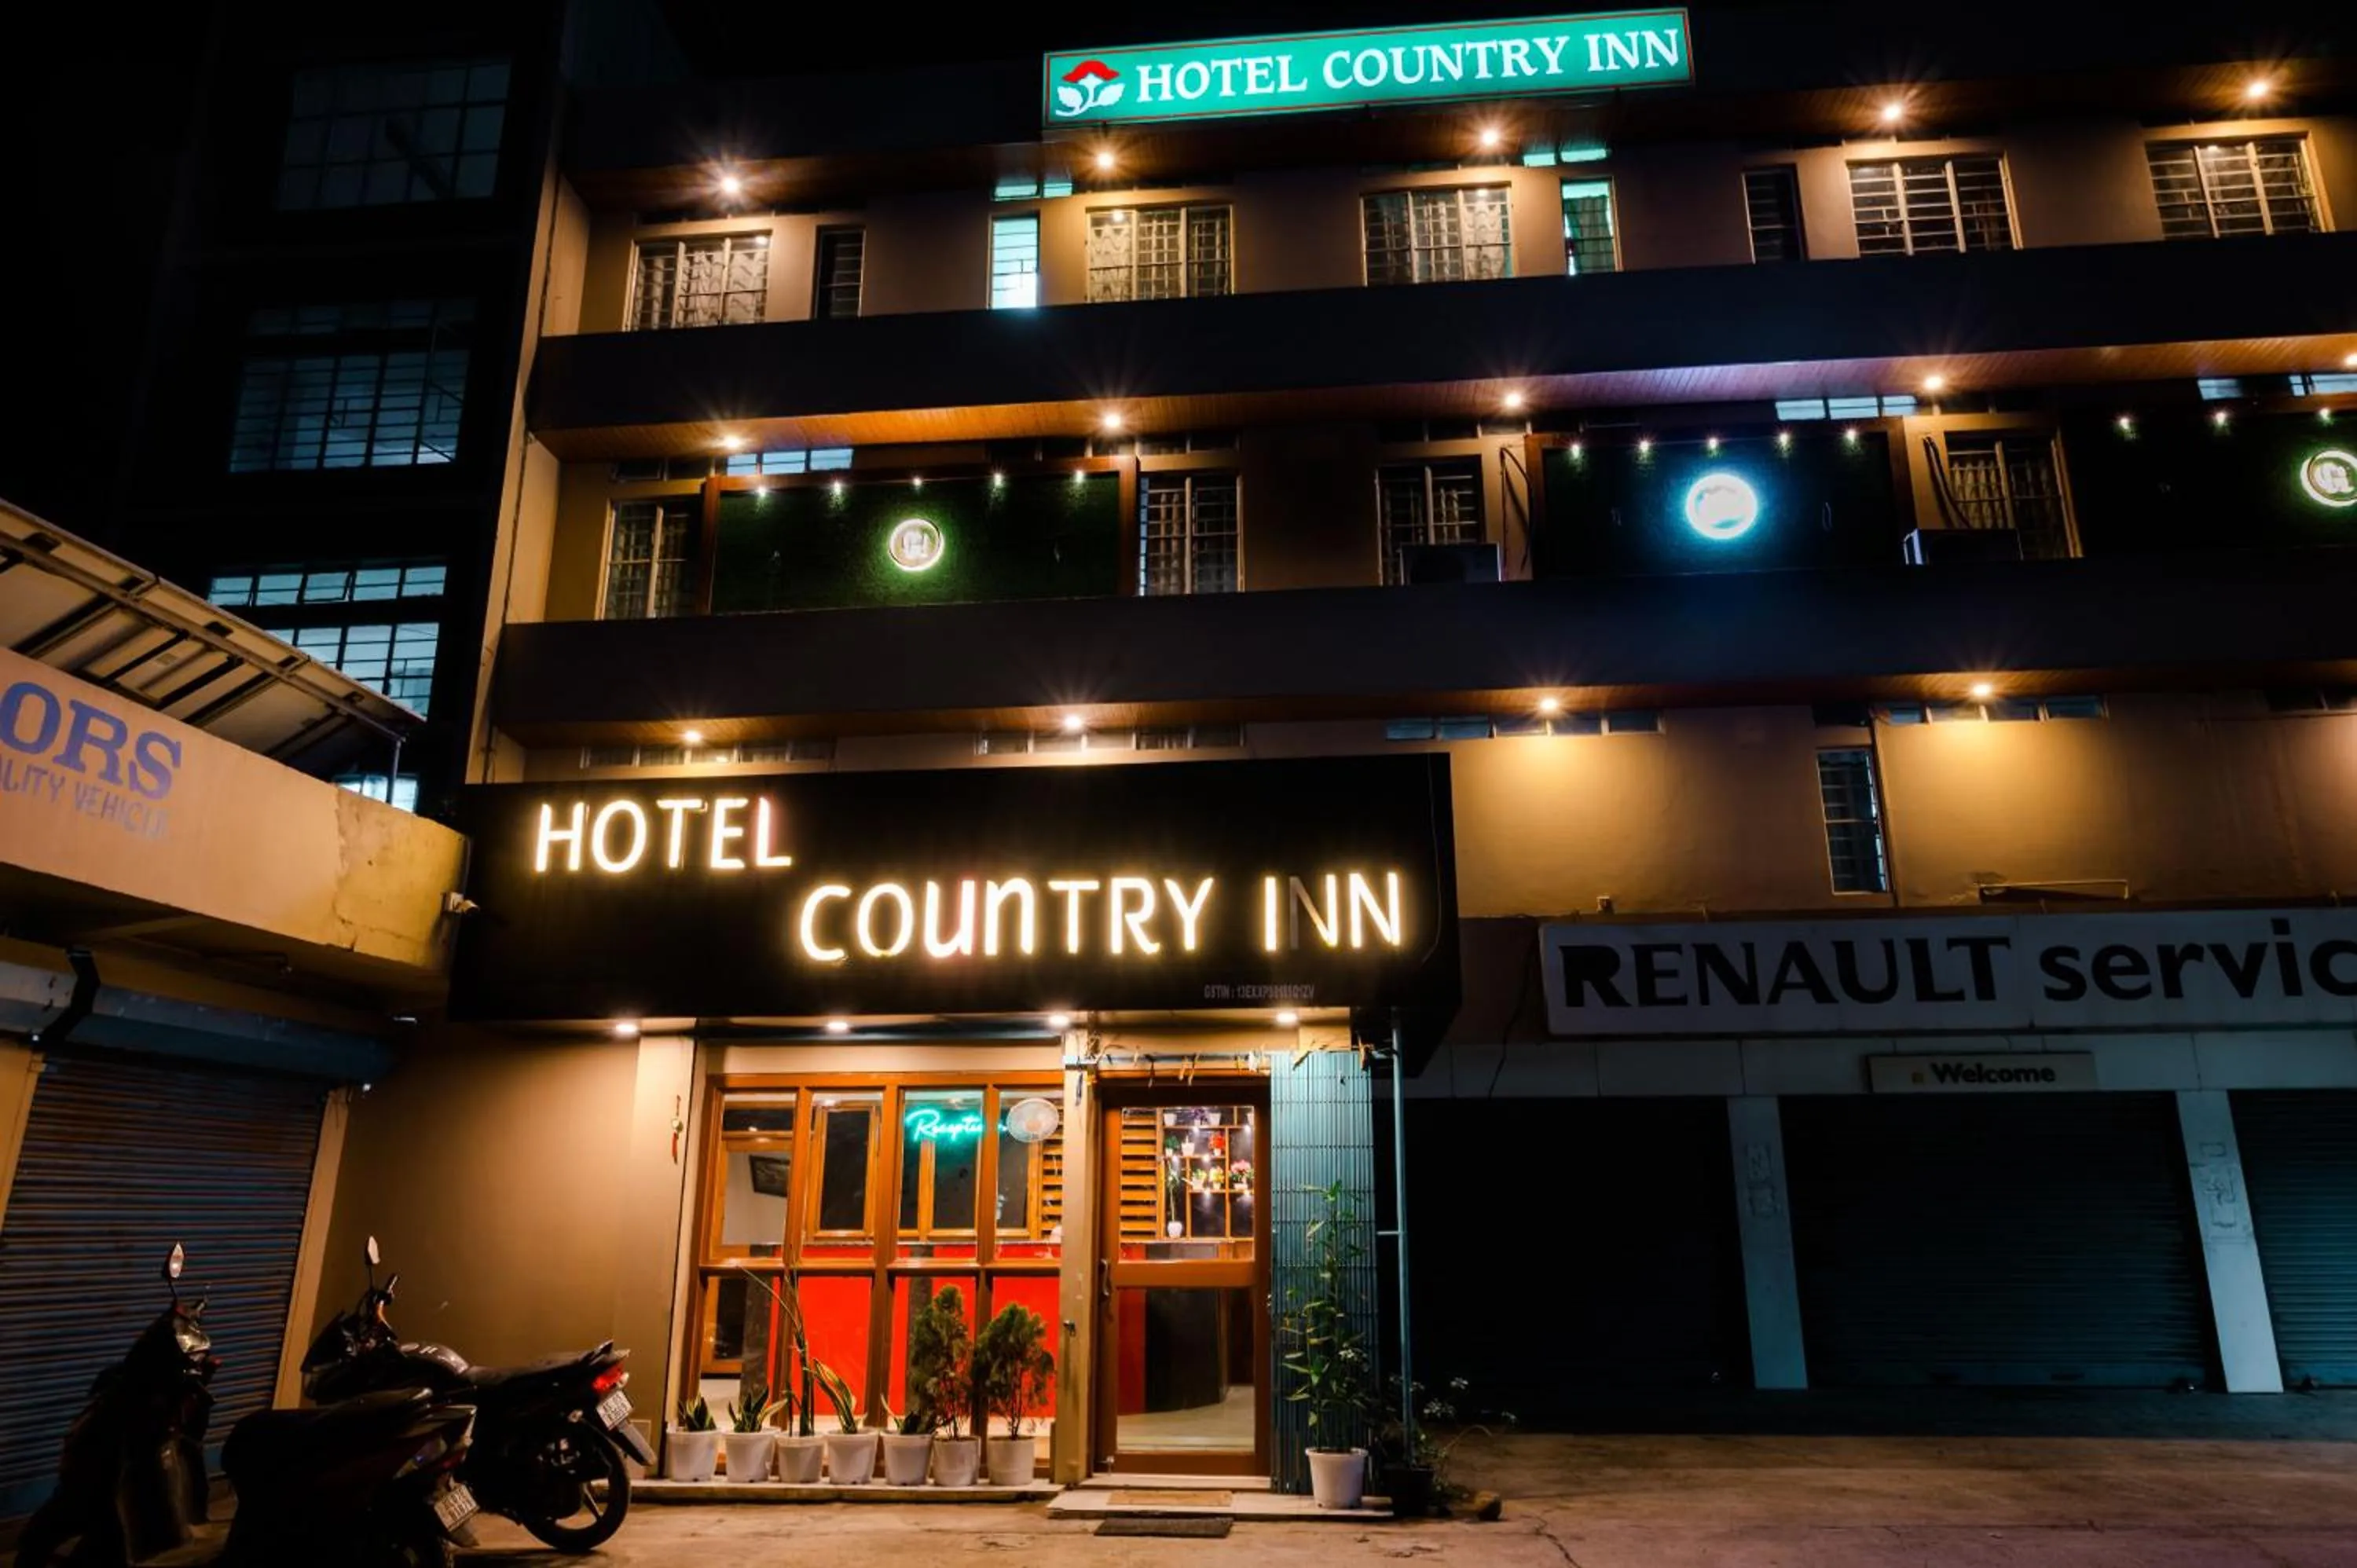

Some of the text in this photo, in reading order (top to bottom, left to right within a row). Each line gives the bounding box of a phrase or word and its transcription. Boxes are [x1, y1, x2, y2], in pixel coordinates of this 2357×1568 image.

[1136, 28, 1679, 102] HOTEL COUNTRY INN
[0, 682, 182, 800] ORS
[535, 796, 792, 873] HOTEL
[1264, 872, 1401, 952] INN
[1558, 937, 2011, 1008] RENAULT
[1930, 1063, 2056, 1083] Welcome
